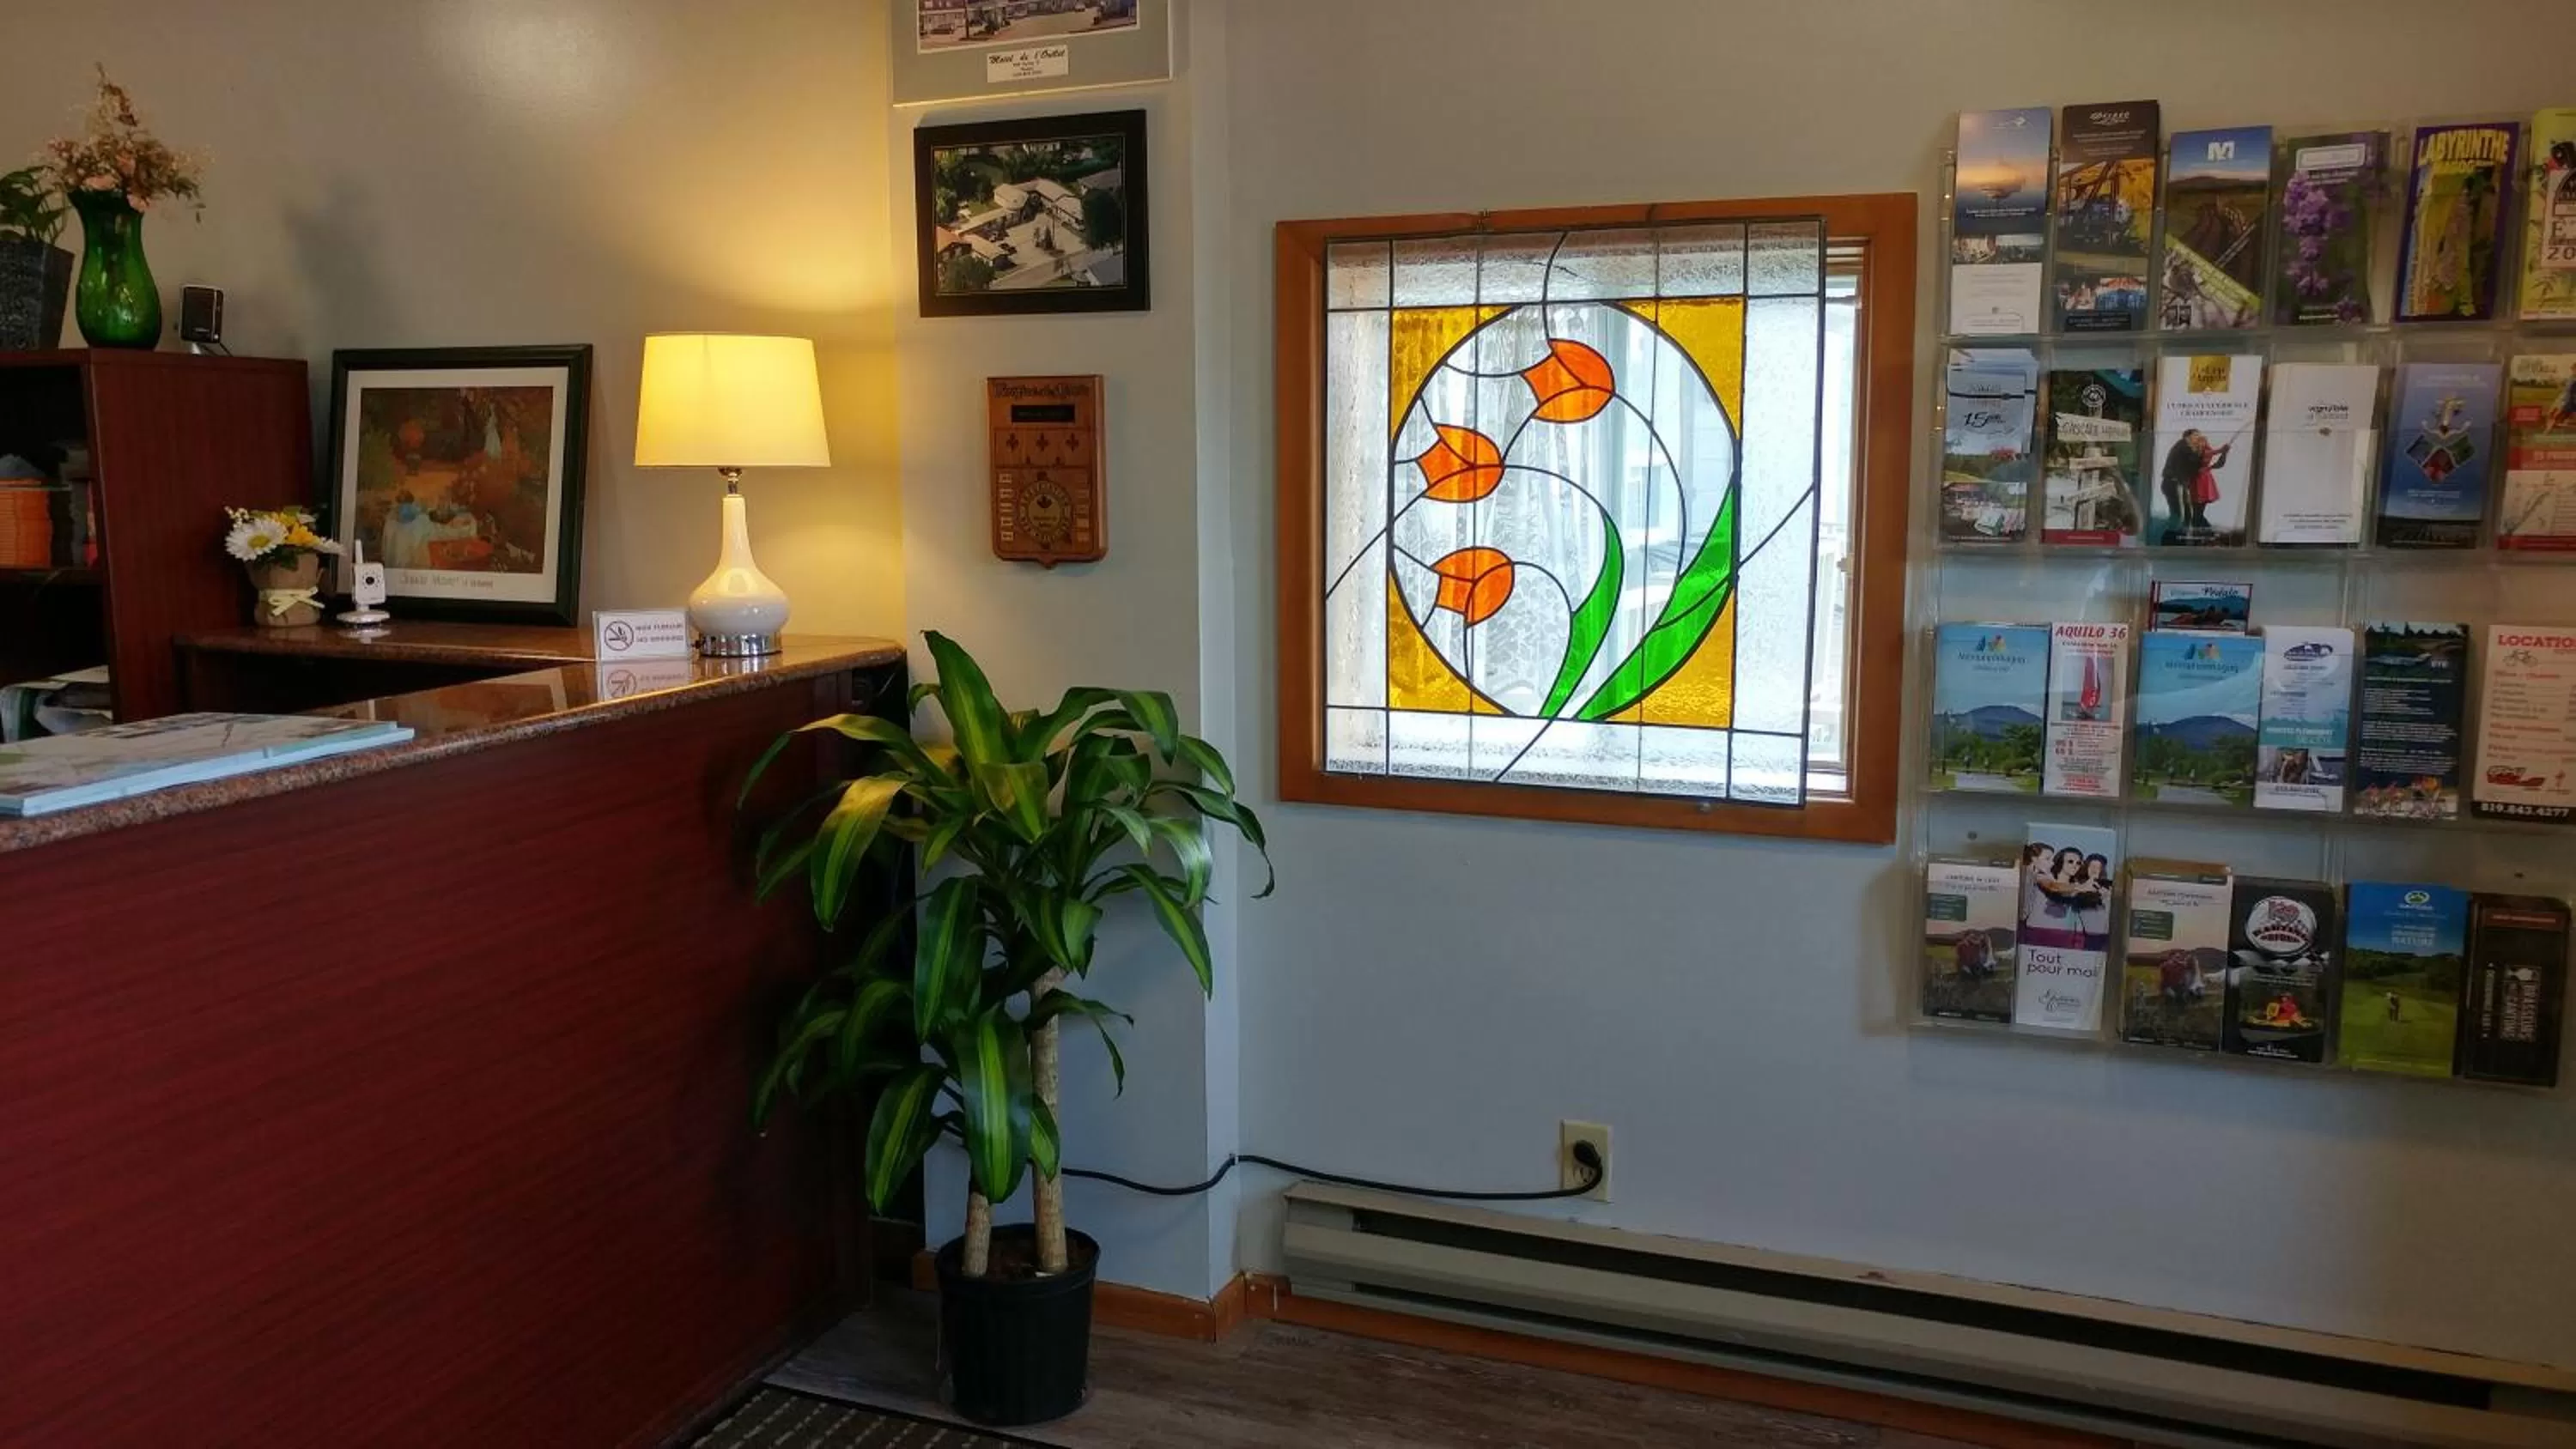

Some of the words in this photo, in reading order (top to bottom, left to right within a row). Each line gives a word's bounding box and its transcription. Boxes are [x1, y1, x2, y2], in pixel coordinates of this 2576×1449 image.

[2418, 129, 2510, 167] LABYRINTHE
[2056, 626, 2104, 639] AQUILO
[2109, 627, 2127, 640] 36
[2497, 634, 2576, 649] LOCATIO
[2027, 948, 2063, 963] Tout
[2026, 963, 2063, 976] pour
[2066, 967, 2098, 979] moi
